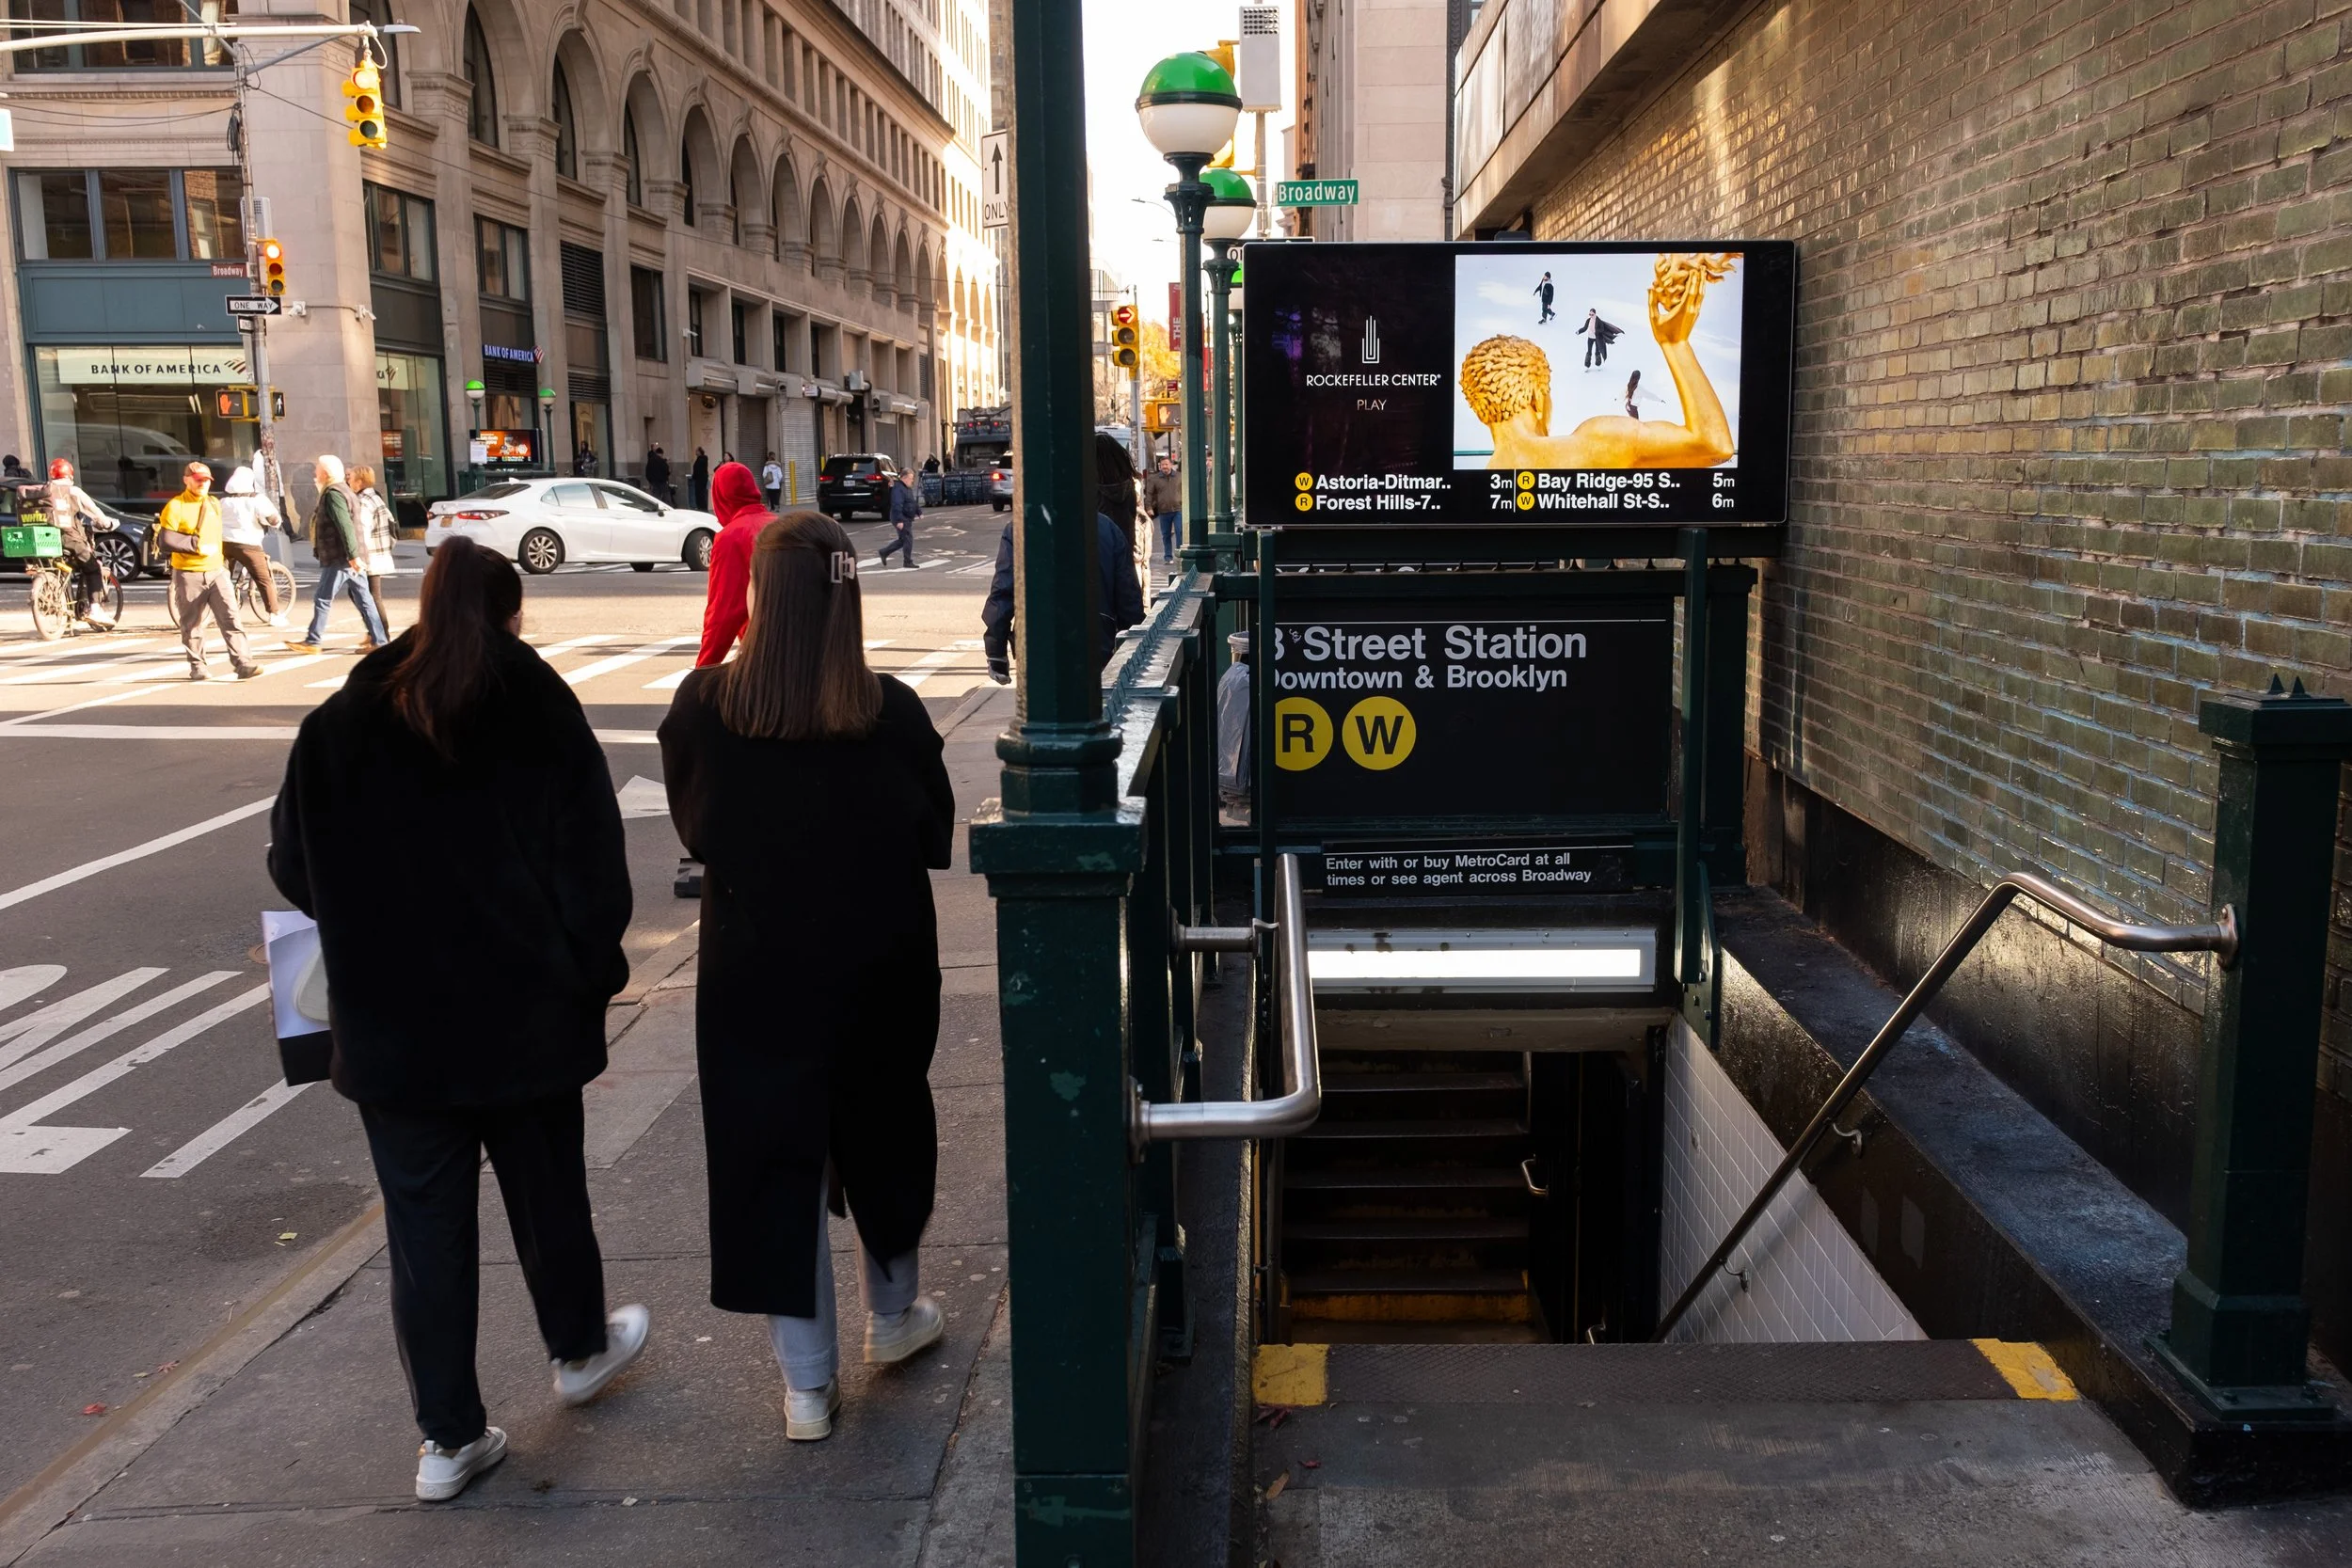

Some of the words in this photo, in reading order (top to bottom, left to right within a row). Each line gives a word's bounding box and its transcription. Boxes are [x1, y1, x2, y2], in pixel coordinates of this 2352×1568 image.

[1279, 182, 1355, 204] Broadway
[984, 201, 1009, 220] ONLY
[213, 265, 244, 277] Broadway
[485, 344, 501, 357] BANK
[501, 347, 509, 358] OF
[509, 348, 534, 362] AMERICA
[91, 365, 130, 373] BANK
[135, 364, 151, 374] OF
[156, 364, 221, 373] AMERICA
[1306, 374, 1389, 387] ROCKEFELLER
[1357, 399, 1387, 411] PLAY
[1537, 473, 1571, 492] Bay
[1576, 472, 1653, 492] Ridge-95
[1316, 495, 1372, 510] Forest
[1537, 494, 1618, 509] Whitehall
[1303, 626, 1426, 661] Street
[1444, 625, 1587, 659] Station
[1275, 667, 1403, 690] owntown
[1415, 664, 1435, 689] &
[1447, 664, 1568, 692] Brooklyn
[1282, 714, 1314, 752] R
[1355, 716, 1404, 754] W
[1326, 857, 1363, 870] Enter
[1369, 856, 1398, 869] with
[1403, 858, 1419, 868] or
[1423, 855, 1450, 870] buy
[1455, 853, 1530, 867] MetroCard
[1535, 853, 1549, 865] at
[1554, 852, 1570, 865] all
[1327, 874, 1365, 886] times
[1371, 875, 1386, 885] or
[1391, 875, 1418, 885] see
[1422, 871, 1464, 887] agent
[1469, 872, 1517, 883] across
[1522, 869, 1592, 883] Broadway
